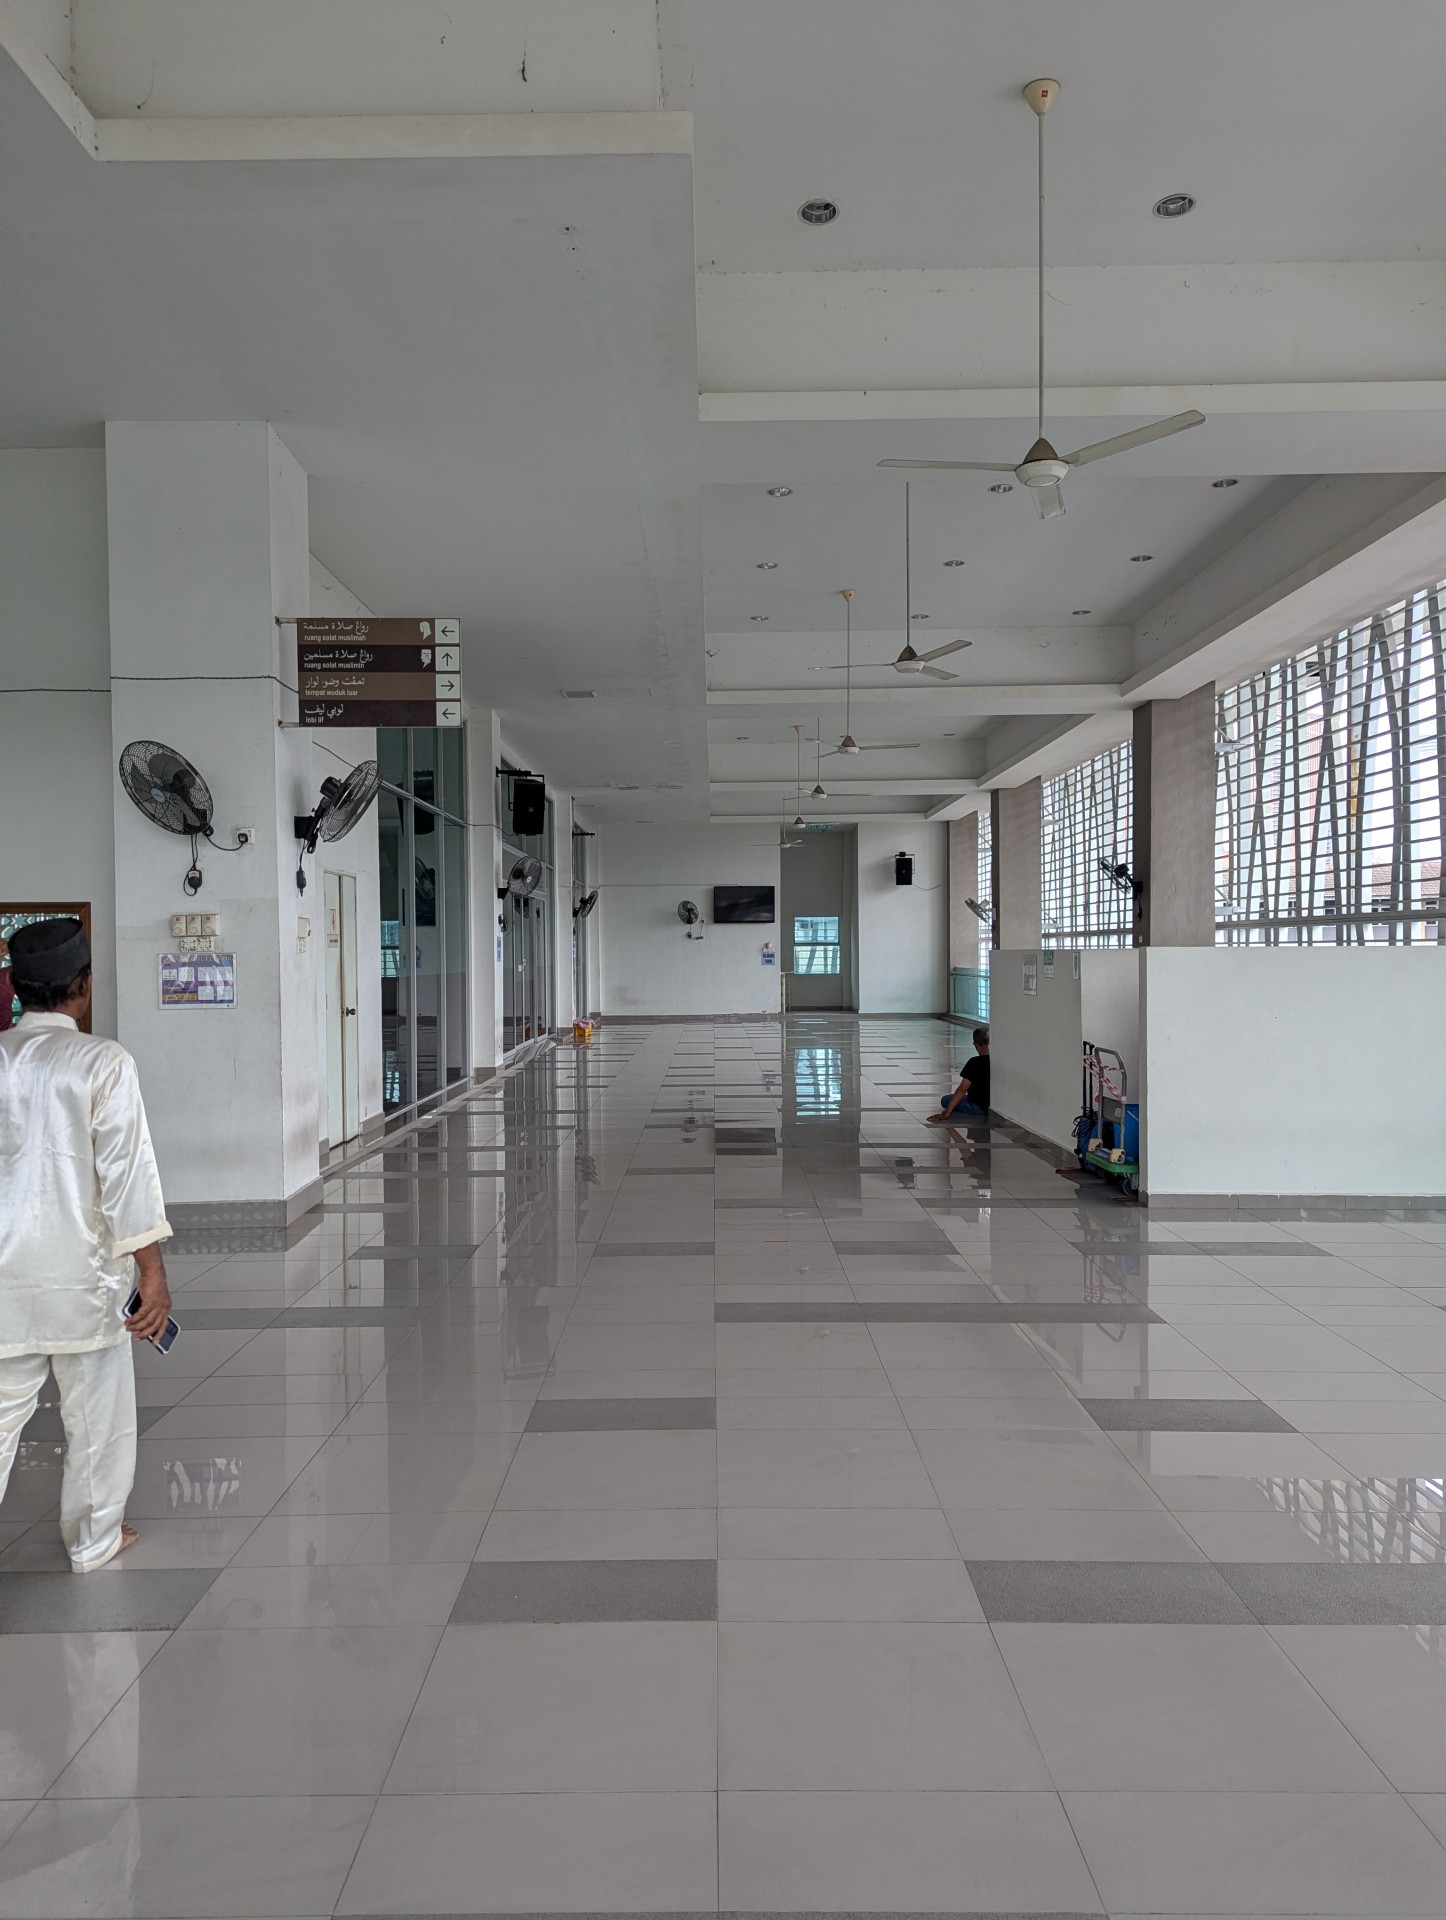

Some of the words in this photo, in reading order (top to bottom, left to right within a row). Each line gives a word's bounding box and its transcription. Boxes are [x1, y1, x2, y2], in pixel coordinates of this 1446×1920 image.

[304, 635, 322, 643] ruang
[304, 662, 322, 670] ruang
[322, 661, 337, 669] solat
[338, 661, 365, 669] muslimin
[305, 689, 326, 698] tempat
[305, 716, 317, 724] lobi
